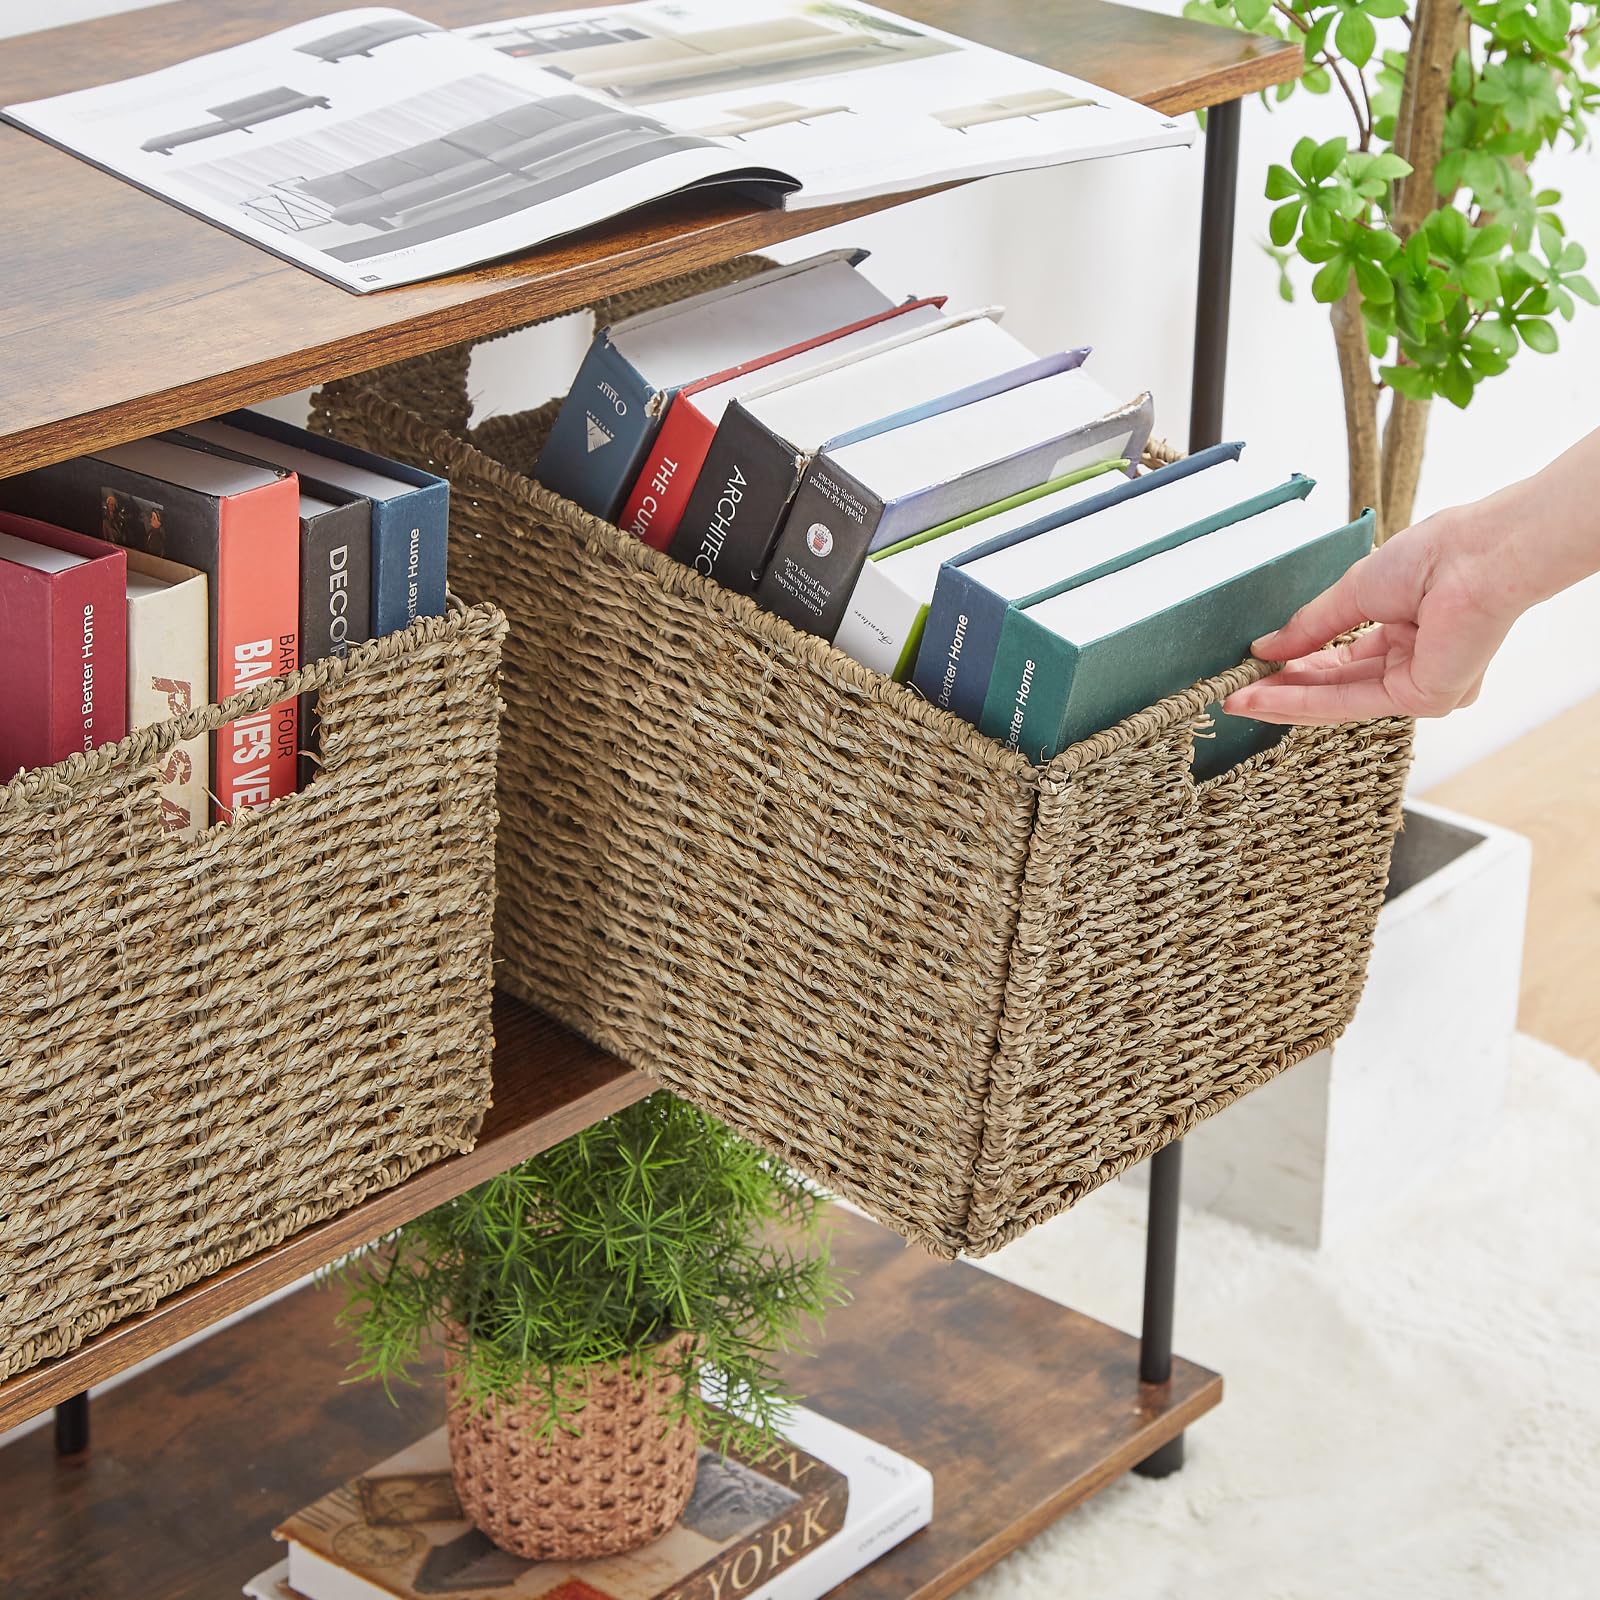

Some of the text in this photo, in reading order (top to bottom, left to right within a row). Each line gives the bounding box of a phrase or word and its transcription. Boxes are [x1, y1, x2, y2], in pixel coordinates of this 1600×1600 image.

[630, 457, 678, 538] THE CUR
[810, 476, 863, 524] World Wide Internet
[818, 473, 867, 514] Changing Societies
[695, 464, 747, 577] ARCHITEC
[407, 528, 420, 578] Home
[785, 557, 830, 597] and Jeffrey Cole
[775, 571, 822, 616] Gustavo Cardoso,
[785, 566, 826, 607] Angus Cheong
[81, 604, 94, 659] Home
[855, 610, 893, 645] Furniture
[938, 614, 969, 707] Better Home
[81, 663, 94, 715] Better
[277, 634, 295, 759] BAR FOUR
[1005, 659, 1036, 752] Better Home
[83, 717, 94, 728] a
[151, 675, 192, 832] PSA
[232, 764, 271, 812] VE
[707, 1497, 829, 1600] YORK
